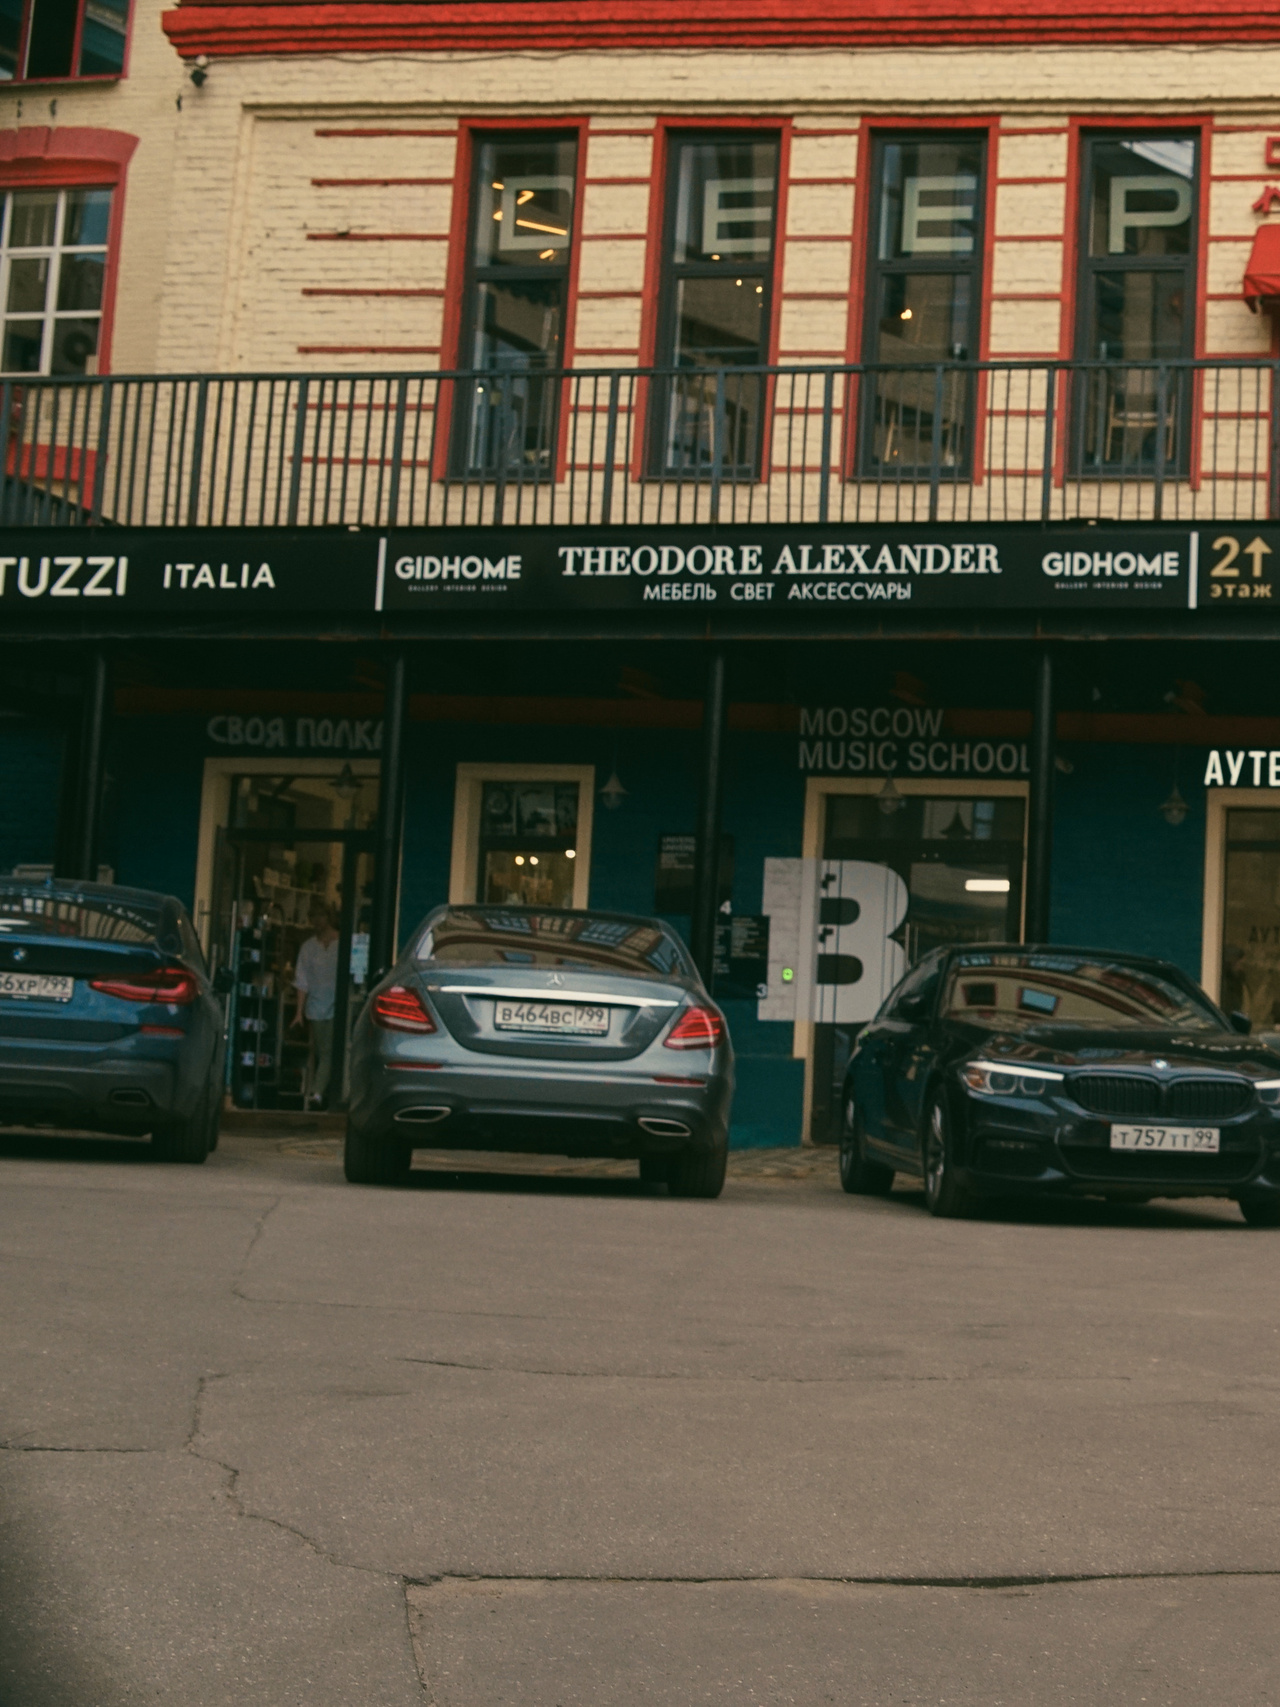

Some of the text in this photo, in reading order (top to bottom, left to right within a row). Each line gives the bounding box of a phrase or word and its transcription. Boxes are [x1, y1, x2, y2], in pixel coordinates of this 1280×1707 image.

[395, 555, 522, 580] GIDHOME
[558, 544, 1002, 576] THEODORE ALEXANDER
[1041, 551, 1179, 577] GIDHOME
[1210, 536, 1240, 577] 2
[163, 563, 275, 589] ITALIA
[643, 582, 912, 600] МЕБЕЛЬ СВЕТ АКСЕССУАРЫ
[1210, 583, 1273, 598] этаж
[206, 715, 287, 748] СВОЯ
[799, 708, 944, 737] MOSCOW
[798, 741, 1030, 773] MUSIC SCHOOL
